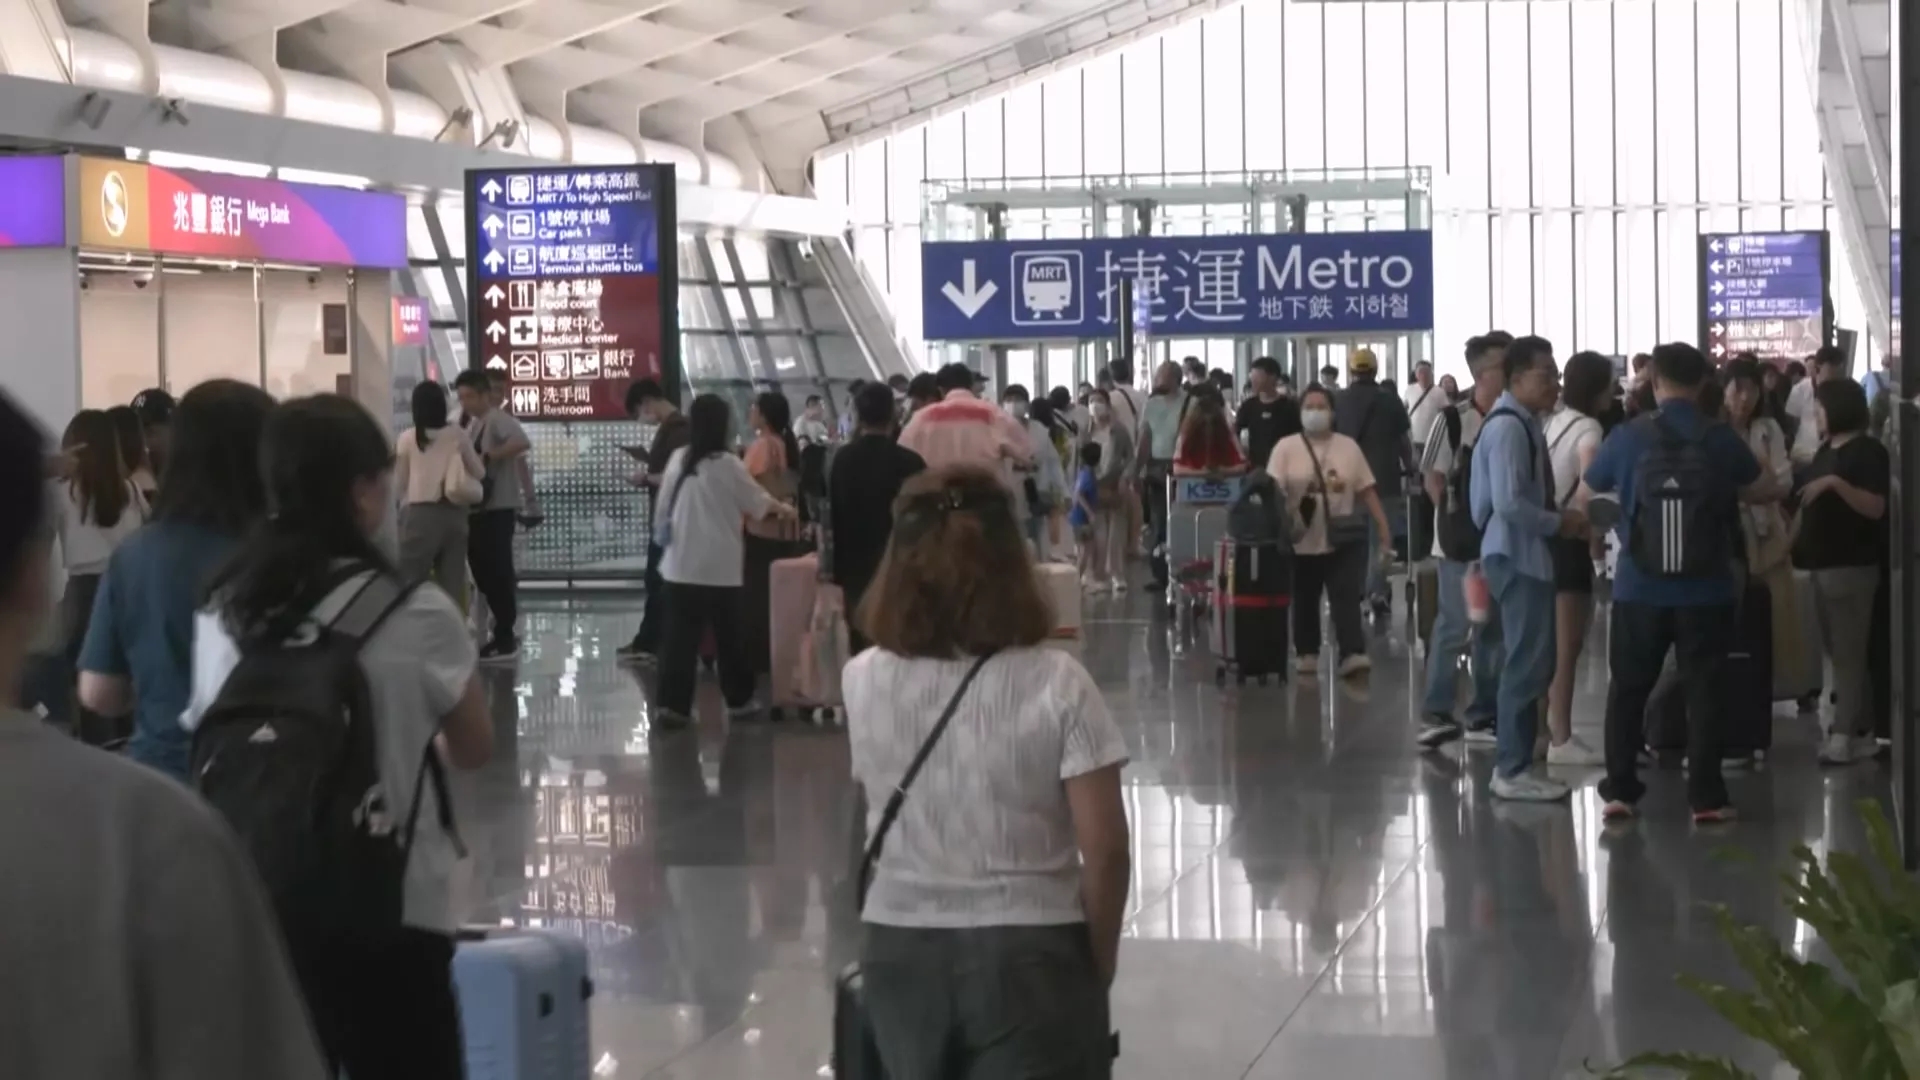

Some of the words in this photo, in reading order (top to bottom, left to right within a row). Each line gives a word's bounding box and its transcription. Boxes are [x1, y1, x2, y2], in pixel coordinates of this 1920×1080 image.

[536, 193, 556, 204] MRT
[565, 192, 577, 203] To
[579, 191, 601, 206] High
[602, 191, 633, 205] Speed
[635, 190, 651, 200] Rail
[173, 190, 242, 237] 兆豐銀行
[247, 200, 269, 228] Mega
[270, 202, 290, 224] Bank
[539, 209, 611, 227] 1號停車場
[539, 228, 556, 239] Car
[559, 227, 584, 240] park
[586, 227, 592, 237] 1
[541, 263, 584, 274] Terminal
[587, 262, 621, 273] shuttle
[623, 260, 643, 272] bus
[1031, 265, 1064, 280] MRT
[1257, 244, 1413, 291] Metro
[541, 279, 603, 298] 美食廣場
[1096, 248, 1247, 324] 捷運
[541, 298, 567, 309] Food
[569, 298, 598, 309] court
[1259, 294, 1334, 320] 地下鉄
[1345, 293, 1408, 319] 지하철
[541, 315, 604, 333] 醫療中心
[541, 333, 583, 345] Medical
[585, 333, 618, 344] center
[604, 348, 635, 367] 銀行
[604, 369, 630, 379] Bank
[543, 385, 590, 403] 洗手間
[543, 404, 593, 415] Restroom
[1188, 482, 1231, 499] KSS
